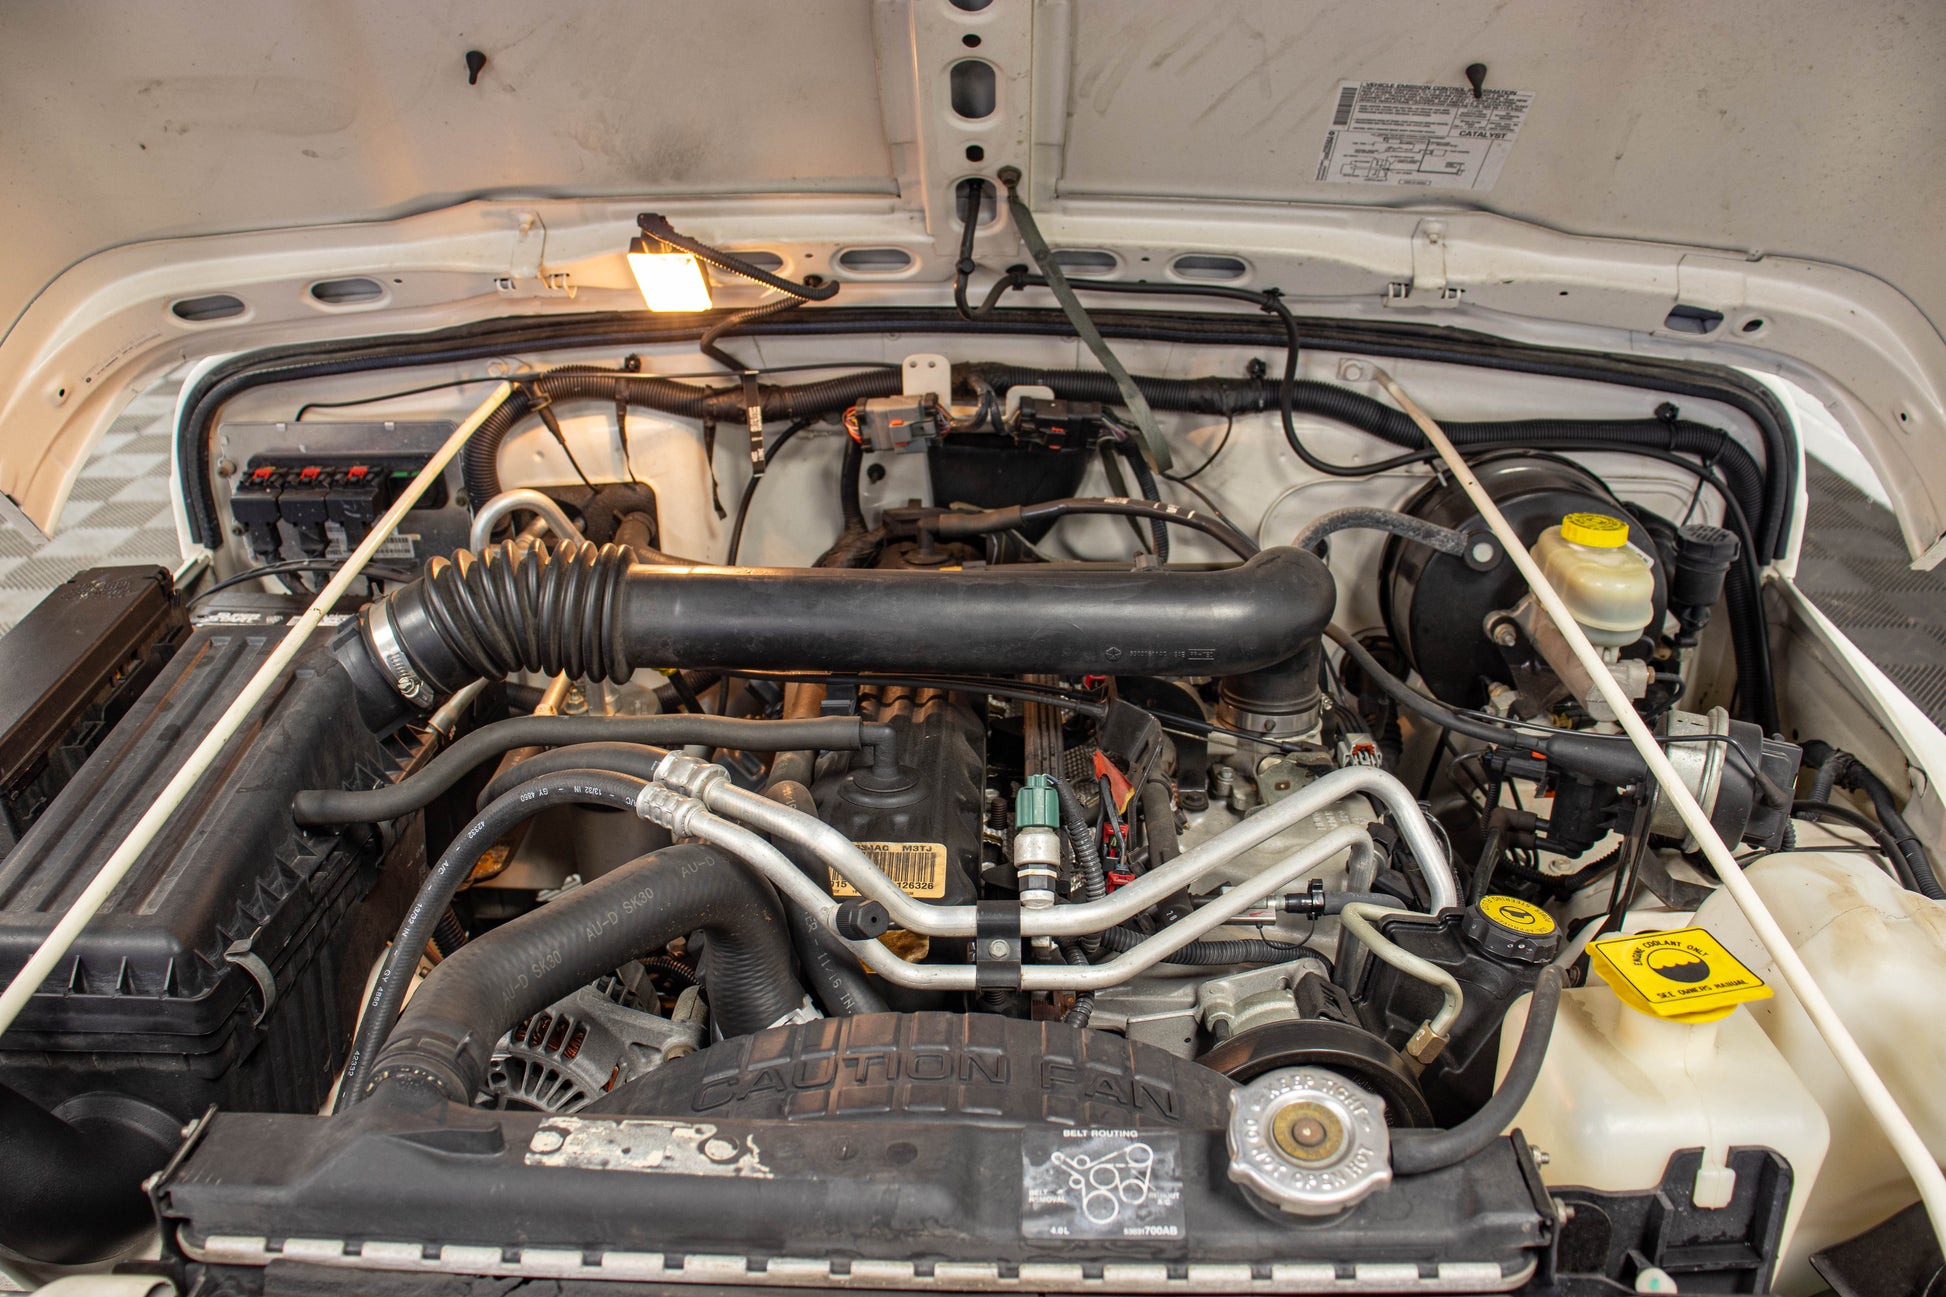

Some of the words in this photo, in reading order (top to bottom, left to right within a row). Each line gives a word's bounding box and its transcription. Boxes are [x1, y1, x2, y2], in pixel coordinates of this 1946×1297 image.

[1459, 130, 1508, 139] CATALYST
[584, 786, 602, 796] 13/32
[406, 903, 423, 924] 13/32
[531, 950, 562, 980] SK30
[585, 911, 619, 942] AU-D
[622, 887, 655, 915] SK30
[680, 855, 715, 879] AU-D
[1643, 940, 1682, 949] COOLANT
[1687, 944, 1710, 958] ONLY
[1657, 991, 1674, 999] SEE
[1715, 979, 1749, 990] MANUAL
[691, 1051, 1010, 1113] CAUTION
[1040, 1060, 1180, 1121] FAN
[1262, 1075, 1314, 1100] KEEP
[1321, 1076, 1369, 1115] TIGHT
[1063, 1129, 1088, 1138] BELT
[1090, 1129, 1138, 1138] ROUTING
[1251, 1149, 1288, 1178] NOT
[1294, 1171, 1347, 1191] OPEN
[1344, 1144, 1375, 1179] HOT
